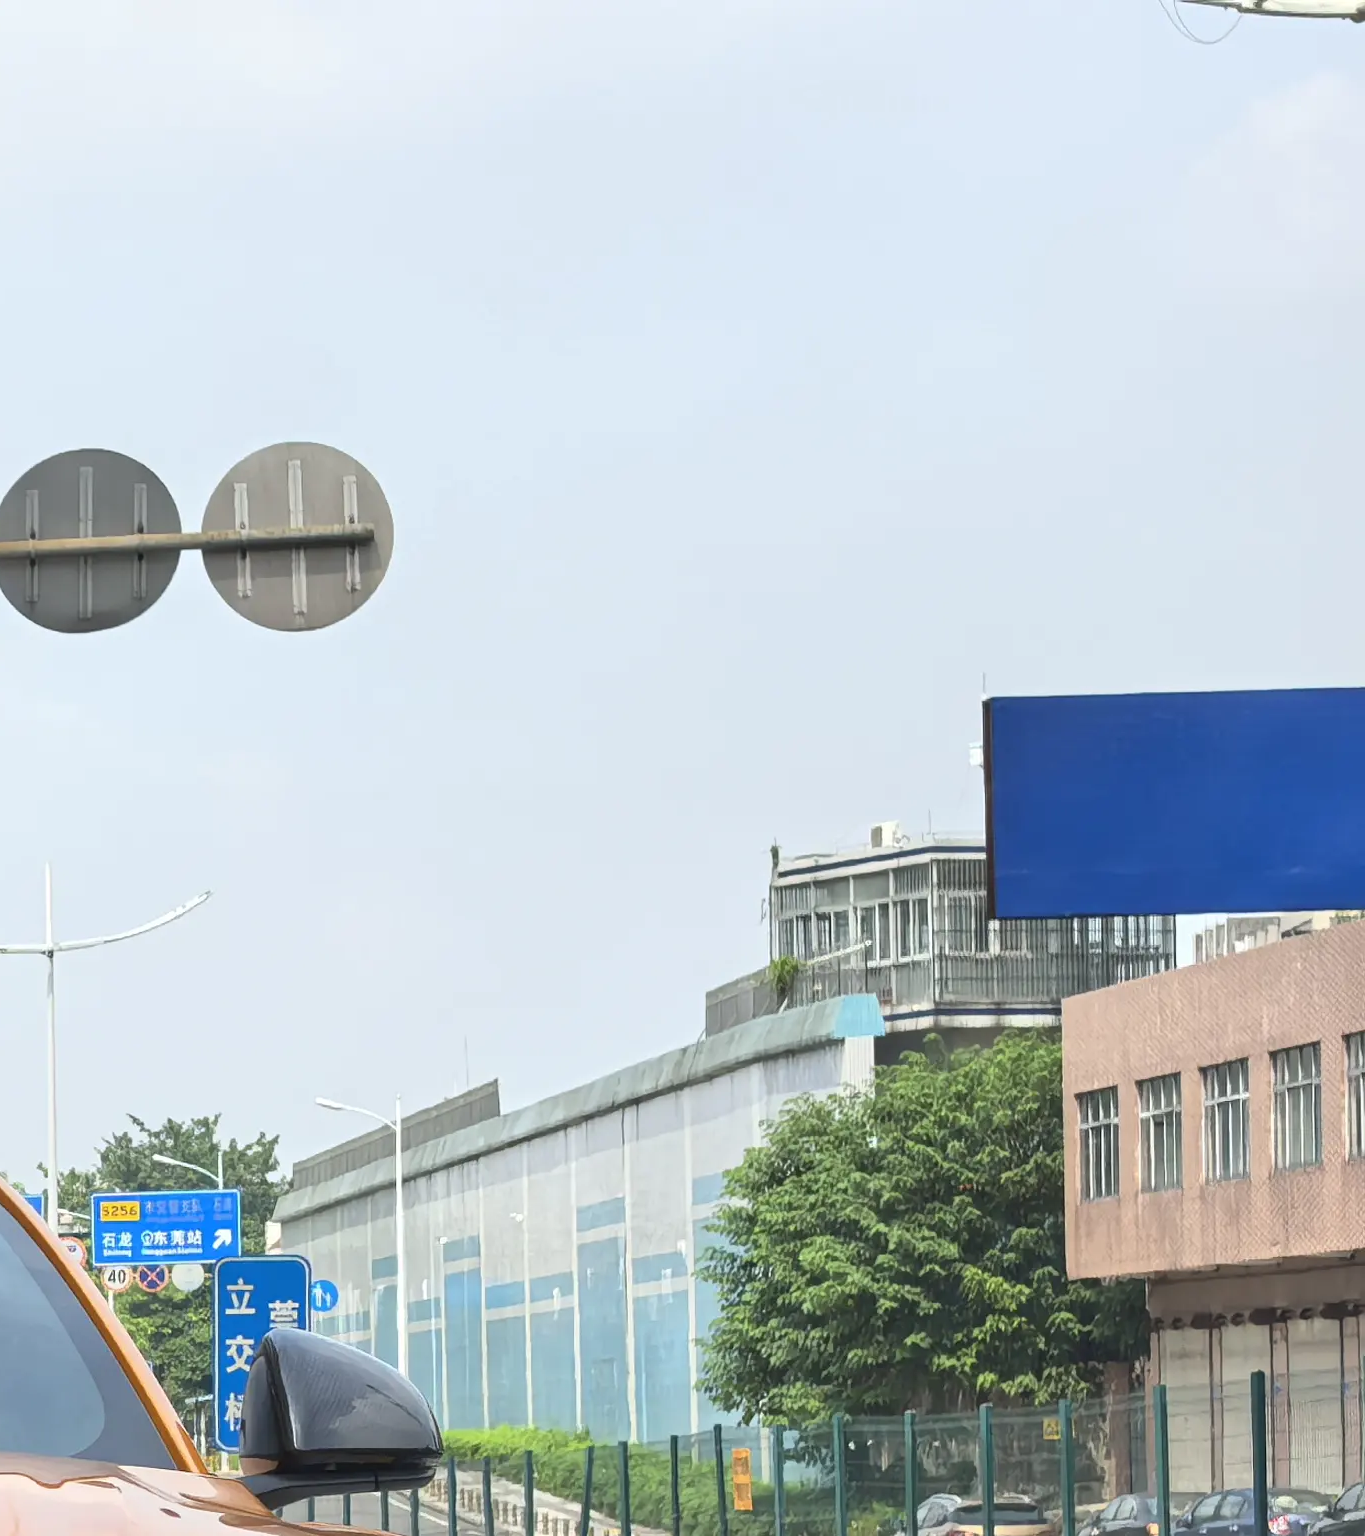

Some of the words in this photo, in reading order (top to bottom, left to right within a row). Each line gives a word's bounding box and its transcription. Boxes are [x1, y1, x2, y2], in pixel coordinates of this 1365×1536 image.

[102, 1205, 138, 1217] S256
[101, 1231, 133, 1248] 石龙
[153, 1229, 203, 1246] 东莞站
[107, 1269, 127, 1284] 40
